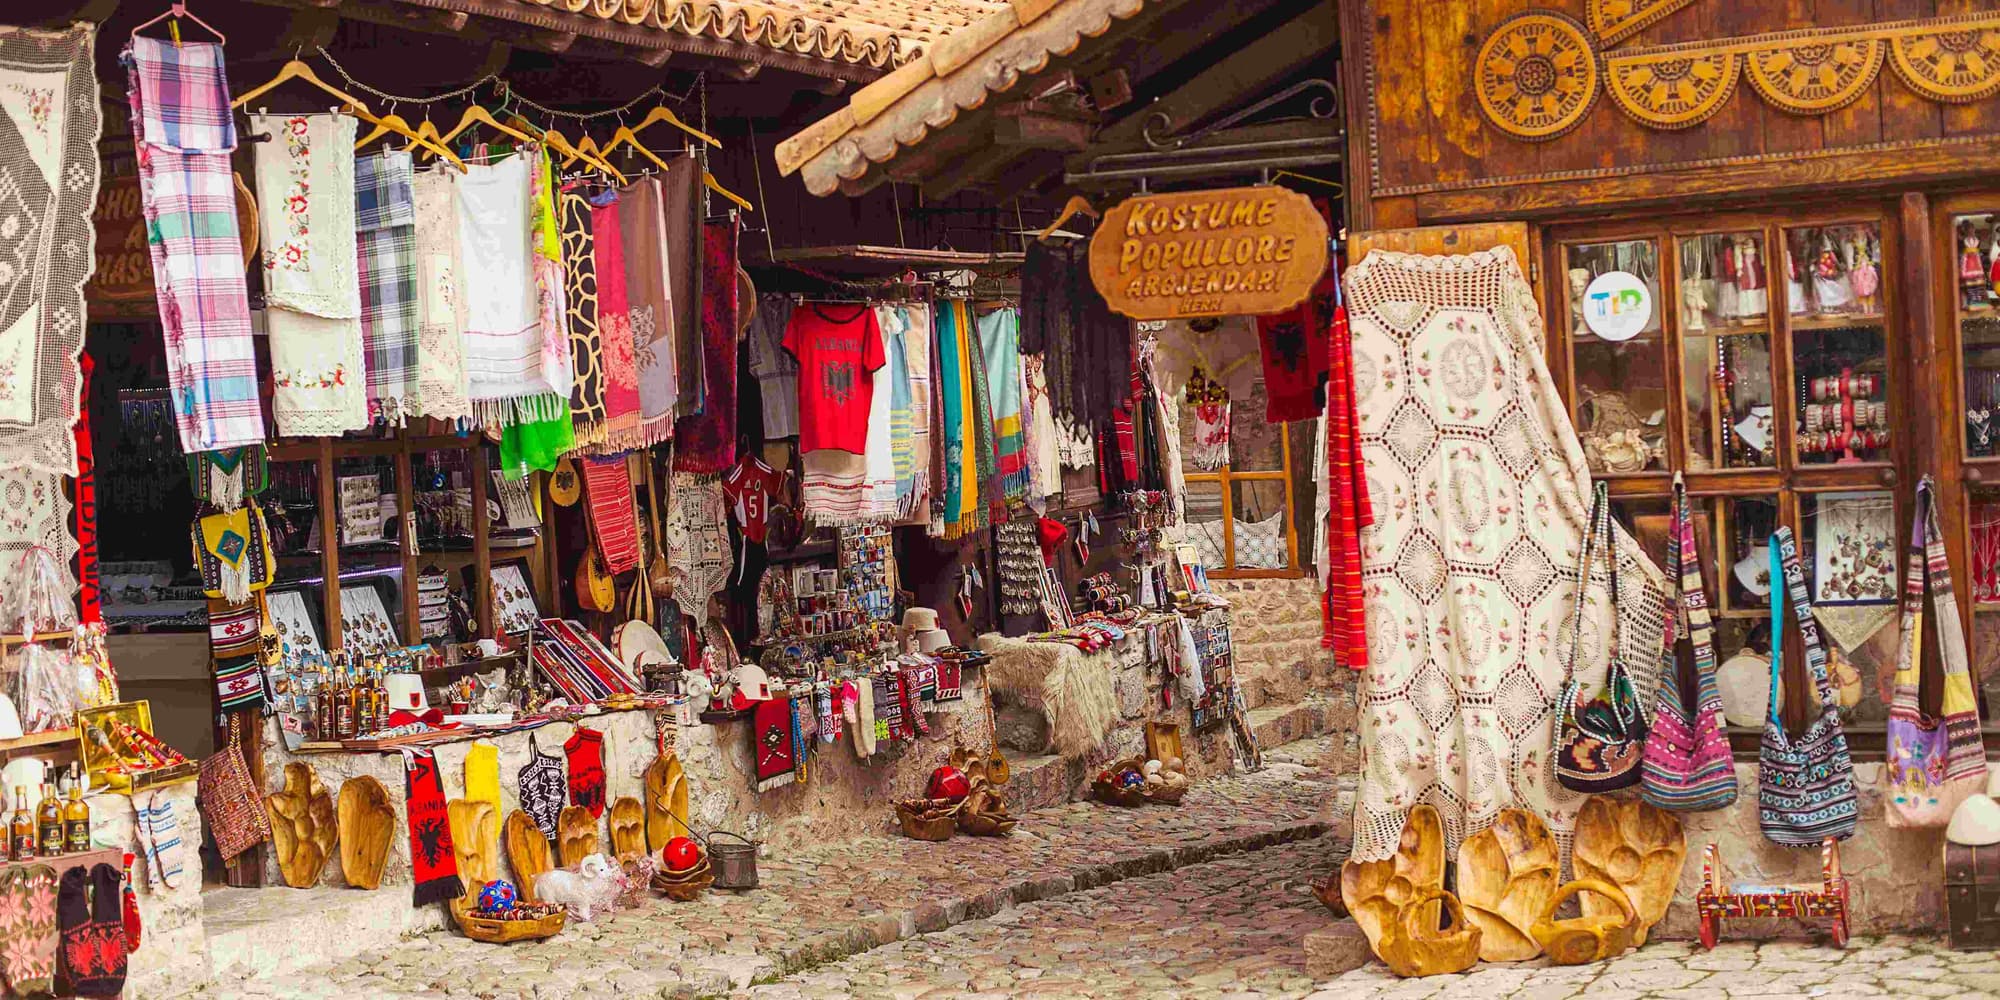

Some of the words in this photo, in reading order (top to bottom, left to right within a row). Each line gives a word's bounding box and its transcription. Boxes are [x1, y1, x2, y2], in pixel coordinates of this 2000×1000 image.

[1126, 199, 1279, 236] KOSTUME
[1119, 233, 1296, 274] POPULLORE
[1126, 268, 1285, 297] ARGJENDARI
[749, 495, 758, 518] 5
